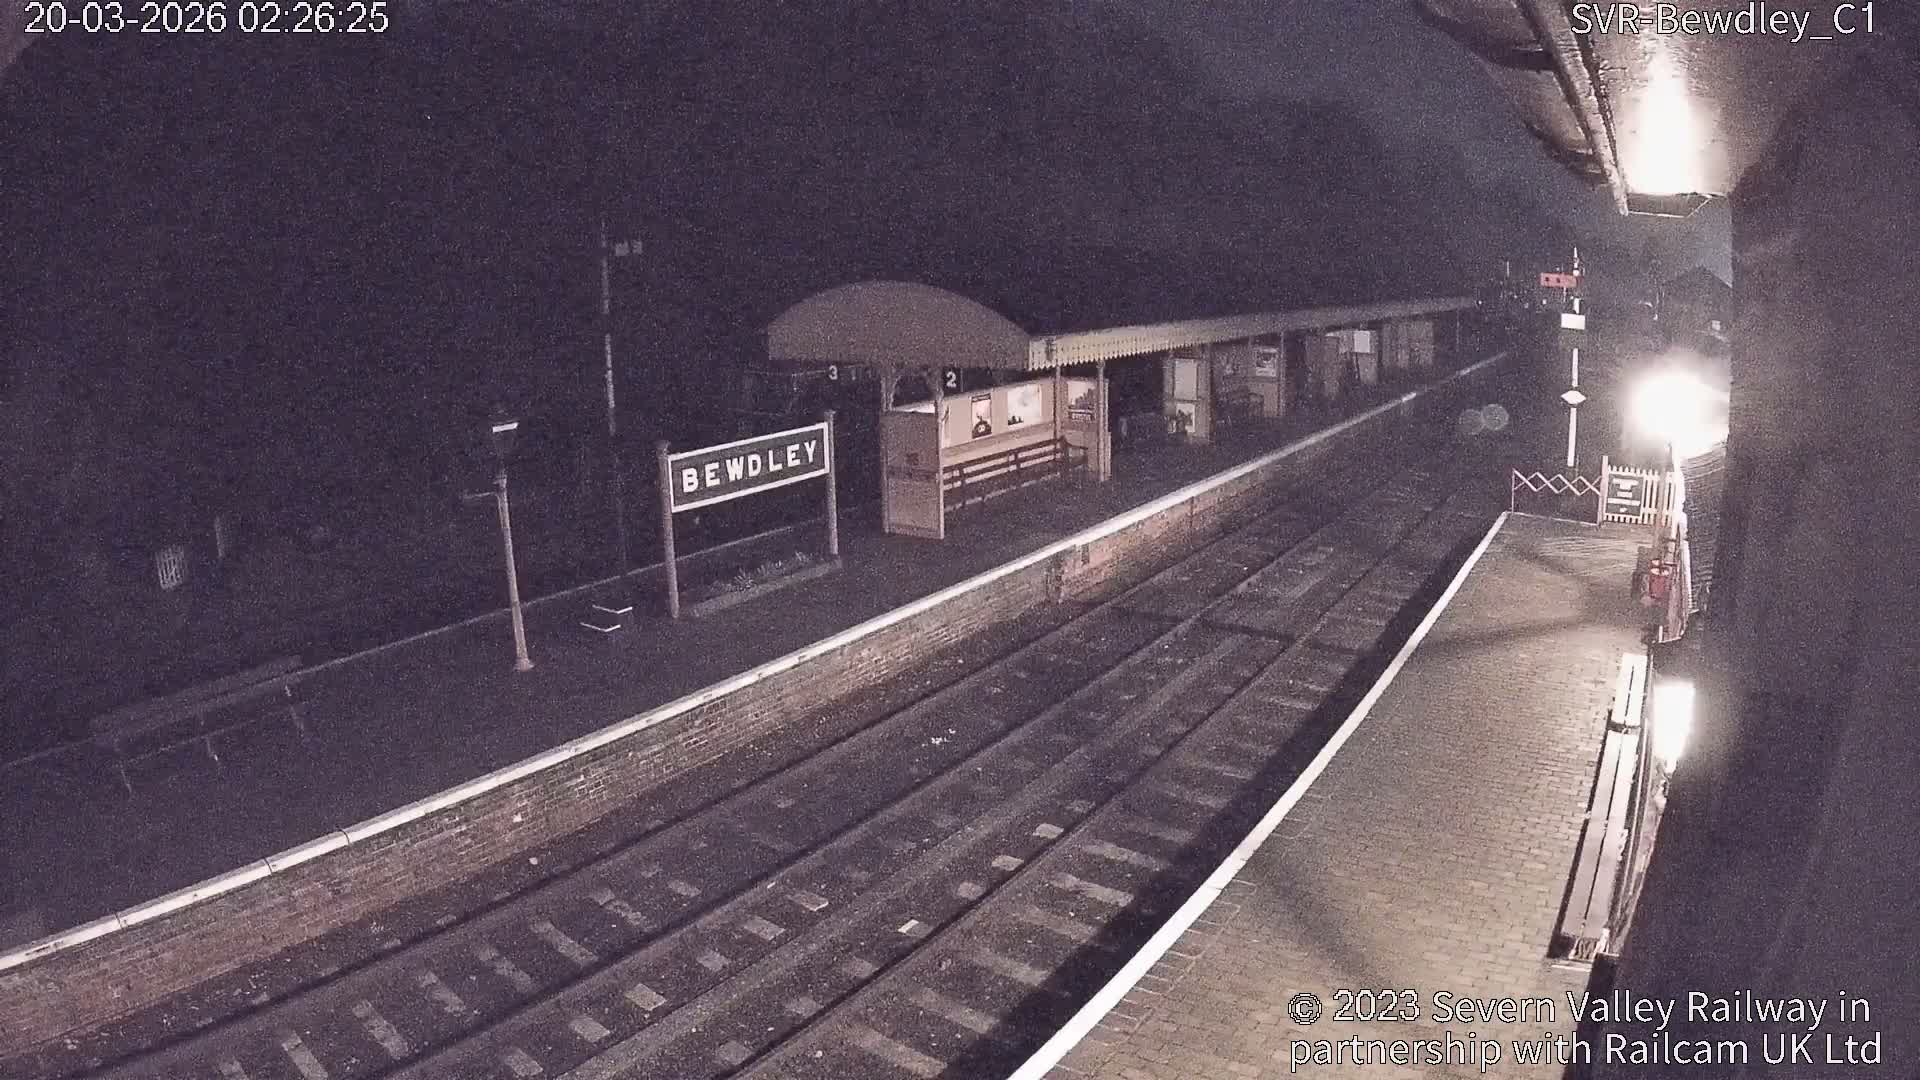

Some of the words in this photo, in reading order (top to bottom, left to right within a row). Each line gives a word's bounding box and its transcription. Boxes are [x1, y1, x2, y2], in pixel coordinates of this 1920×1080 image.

[828, 365, 838, 380] 3
[945, 371, 957, 388] 2
[681, 440, 817, 493] BEWDLEY
